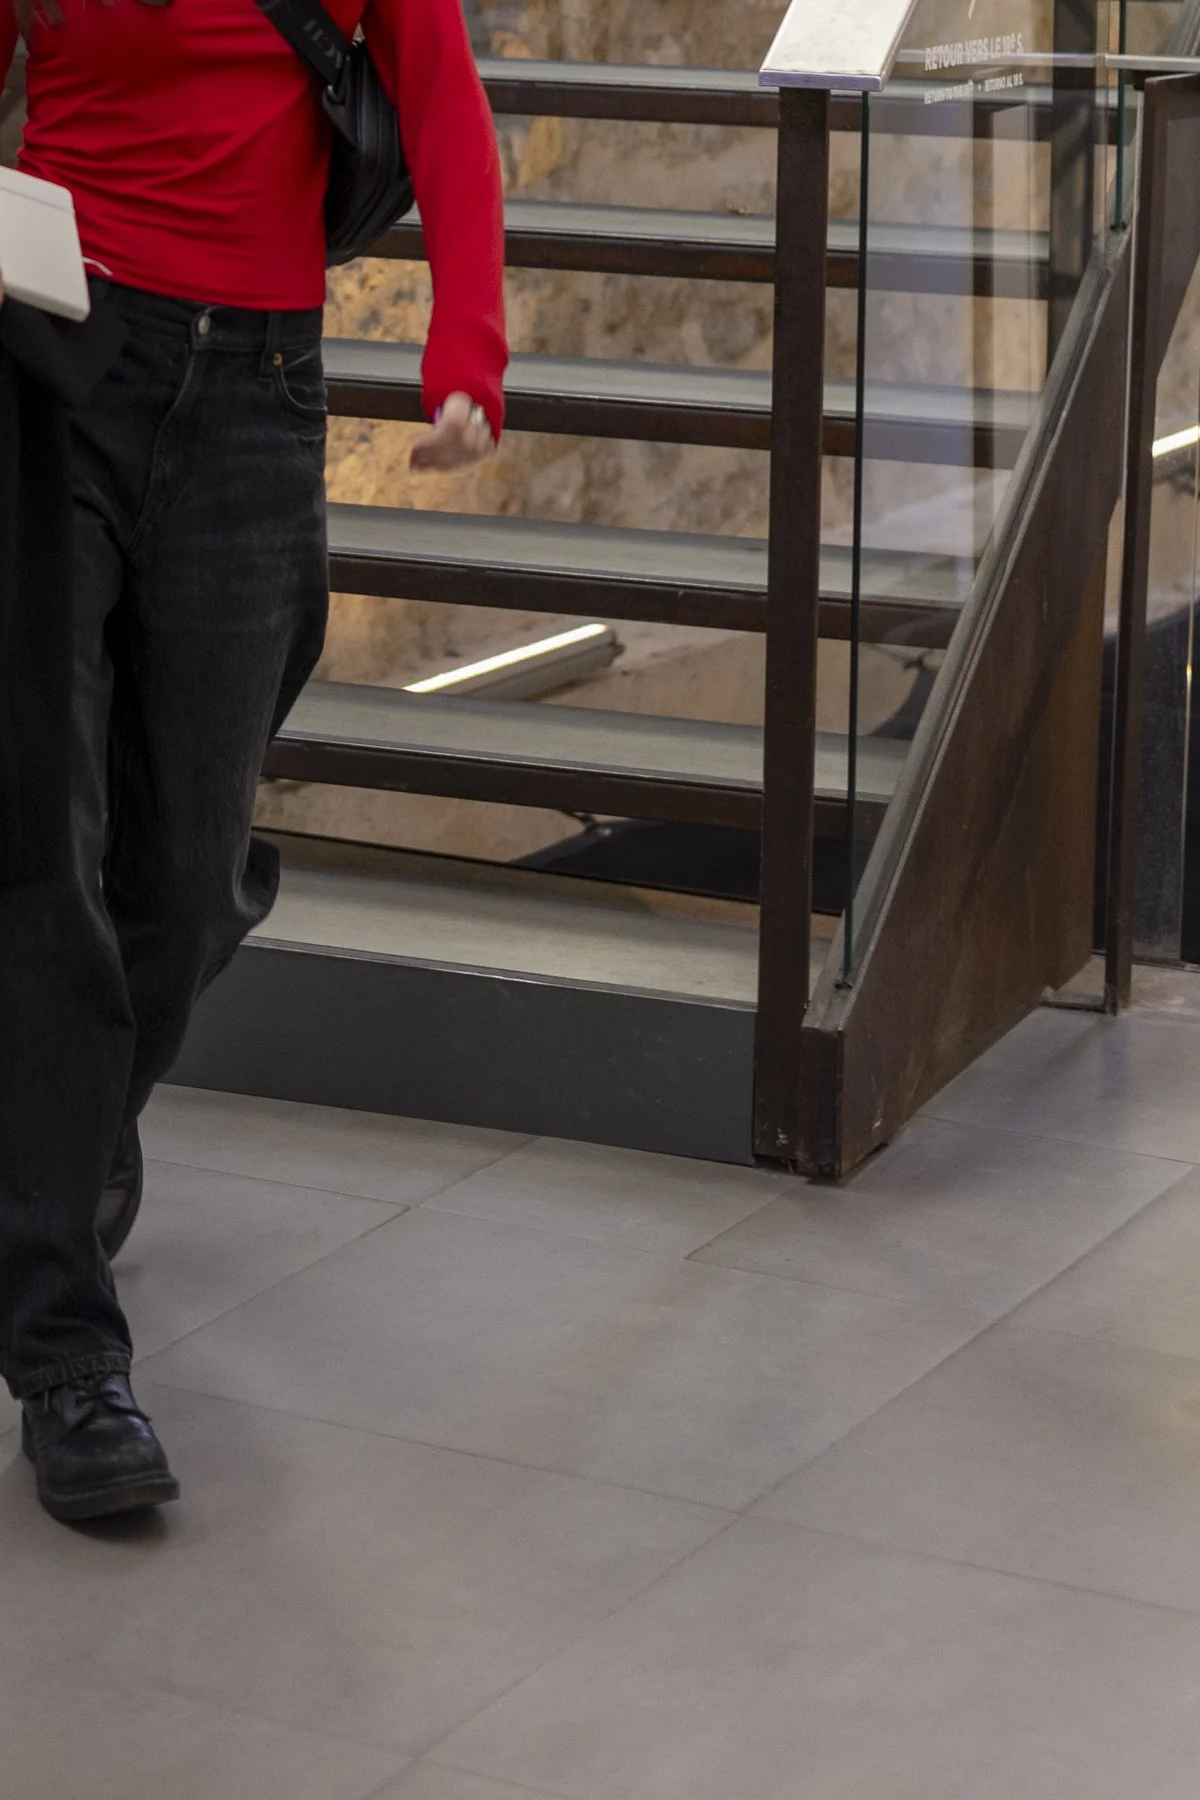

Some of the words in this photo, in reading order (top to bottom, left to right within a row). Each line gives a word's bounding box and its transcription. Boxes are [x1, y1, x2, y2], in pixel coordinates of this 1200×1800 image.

[924, 42, 963, 72] RETOUR
[965, 38, 989, 63] VERS
[990, 36, 1001, 59] LE
